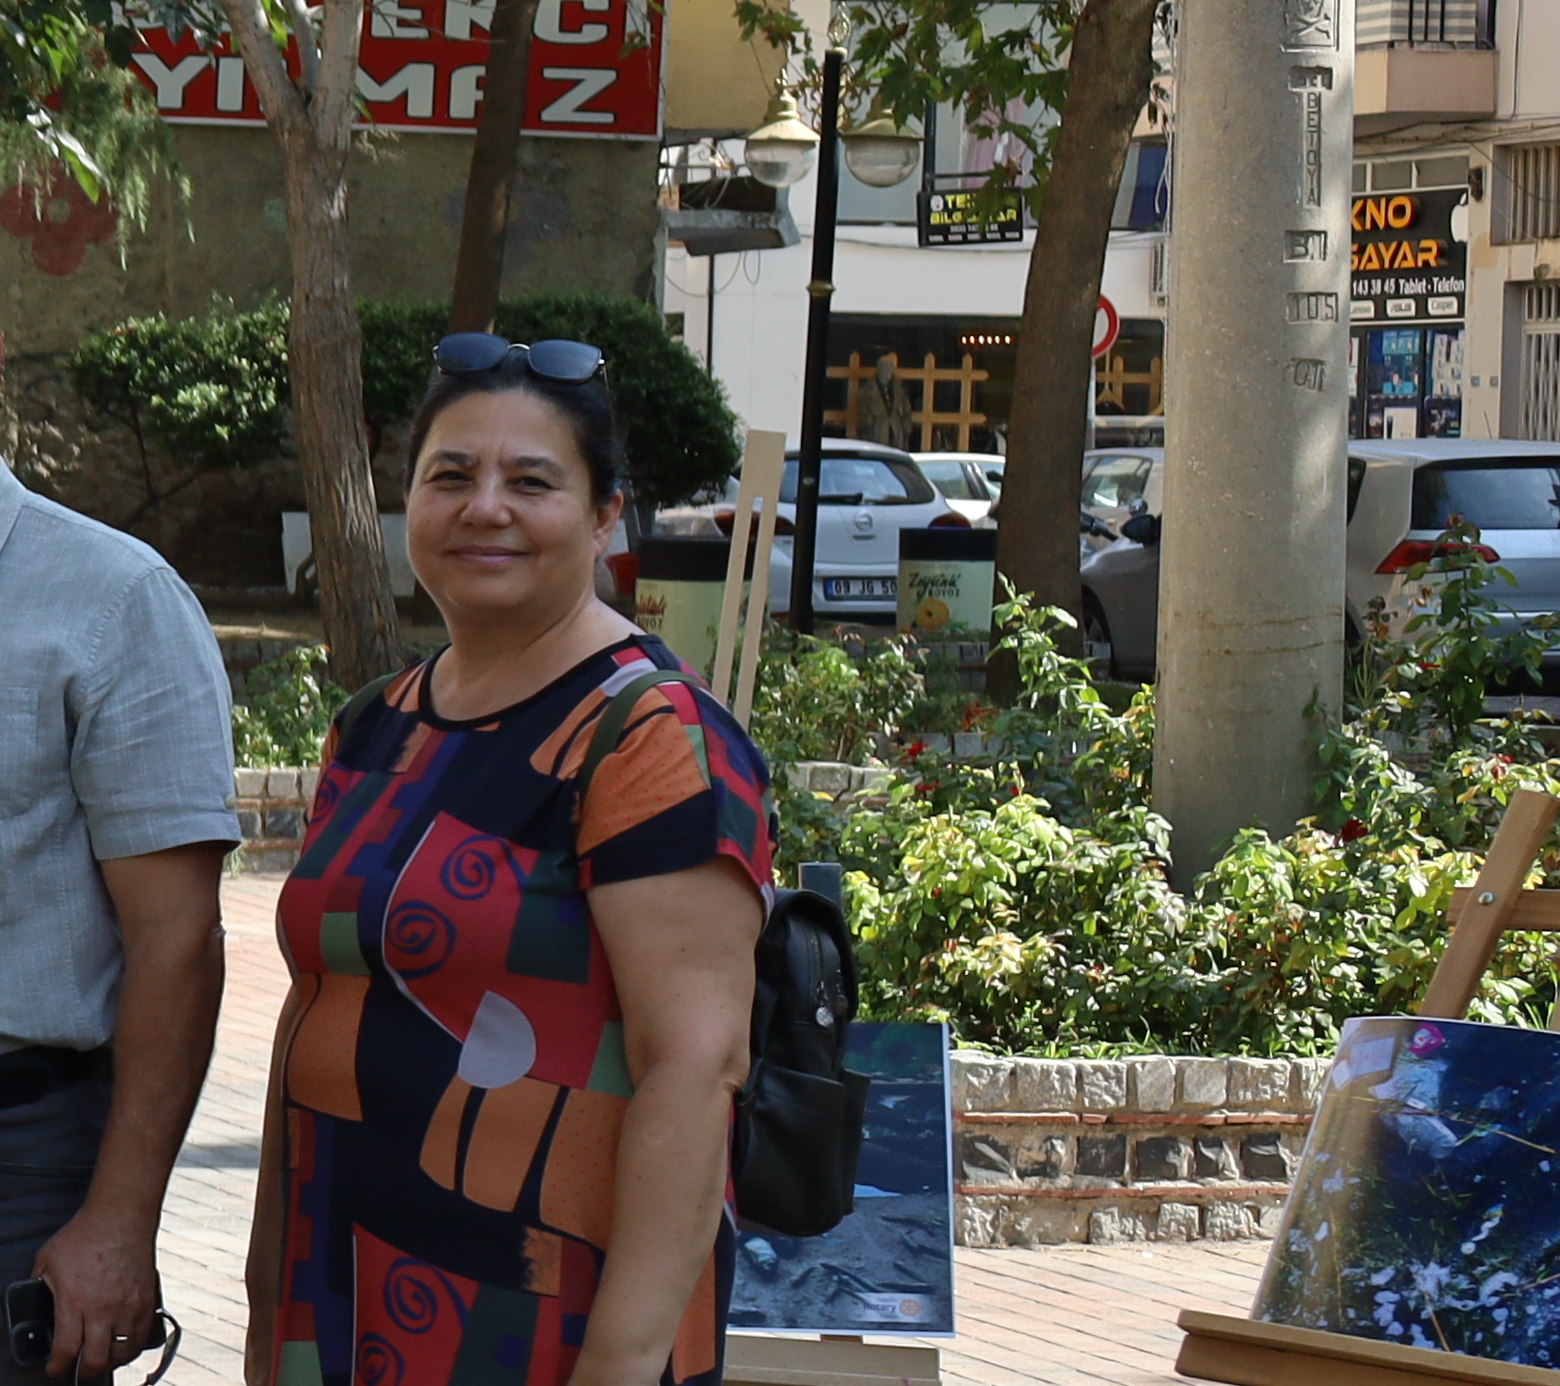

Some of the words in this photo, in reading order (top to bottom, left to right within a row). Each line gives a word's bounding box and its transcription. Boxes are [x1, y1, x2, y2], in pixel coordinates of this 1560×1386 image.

[131, 52, 618, 124] YIMZ
[834, 580, 850, 594] 09
[863, 1301, 897, 1313] Rotary
